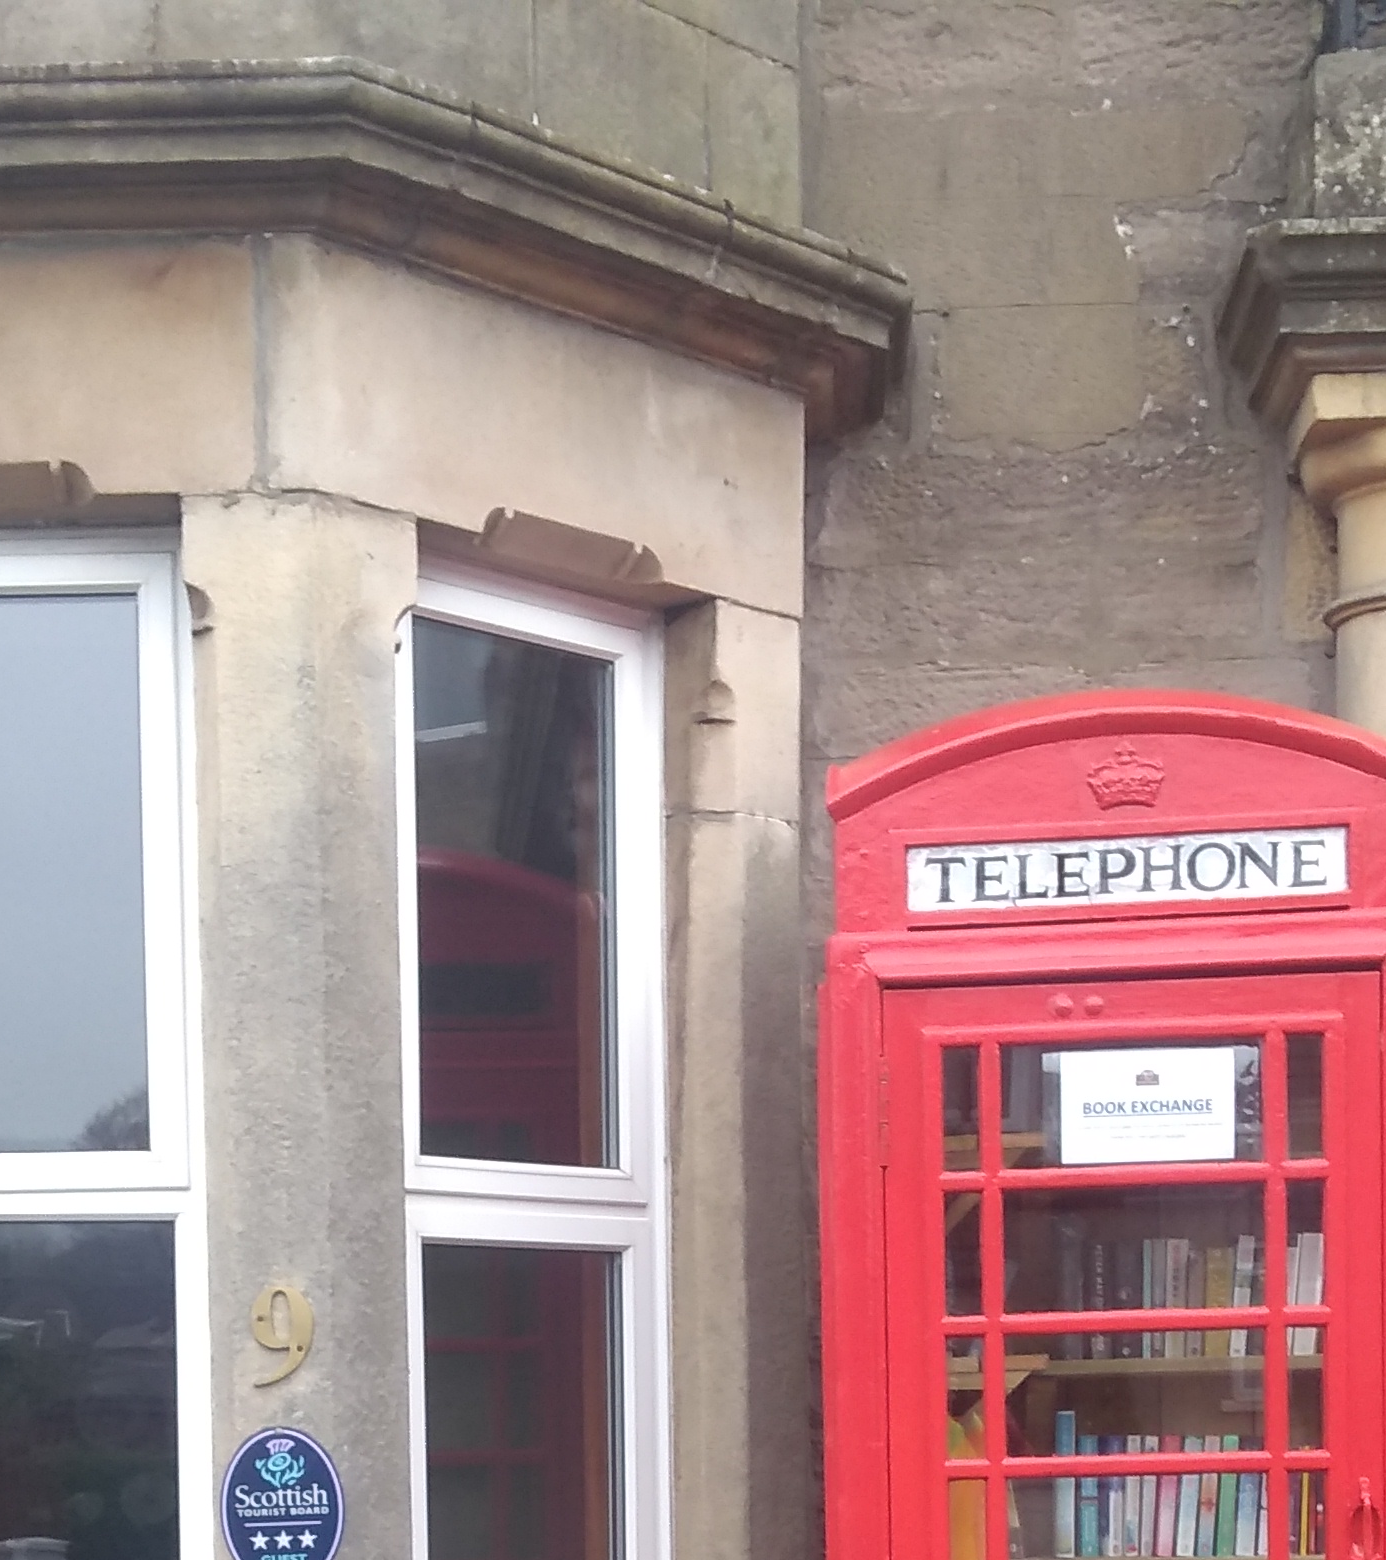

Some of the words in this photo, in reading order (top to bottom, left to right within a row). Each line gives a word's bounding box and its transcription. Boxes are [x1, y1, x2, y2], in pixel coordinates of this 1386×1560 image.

[924, 839, 1328, 903] TELEPHONE
[1082, 1101, 1126, 1116] BOOK
[1130, 1098, 1213, 1114] EXCHANGE
[251, 1286, 315, 1388] 9
[234, 1483, 329, 1509] Scottish
[236, 1507, 286, 1518] TOURIST
[289, 1506, 330, 1516] BOARD
